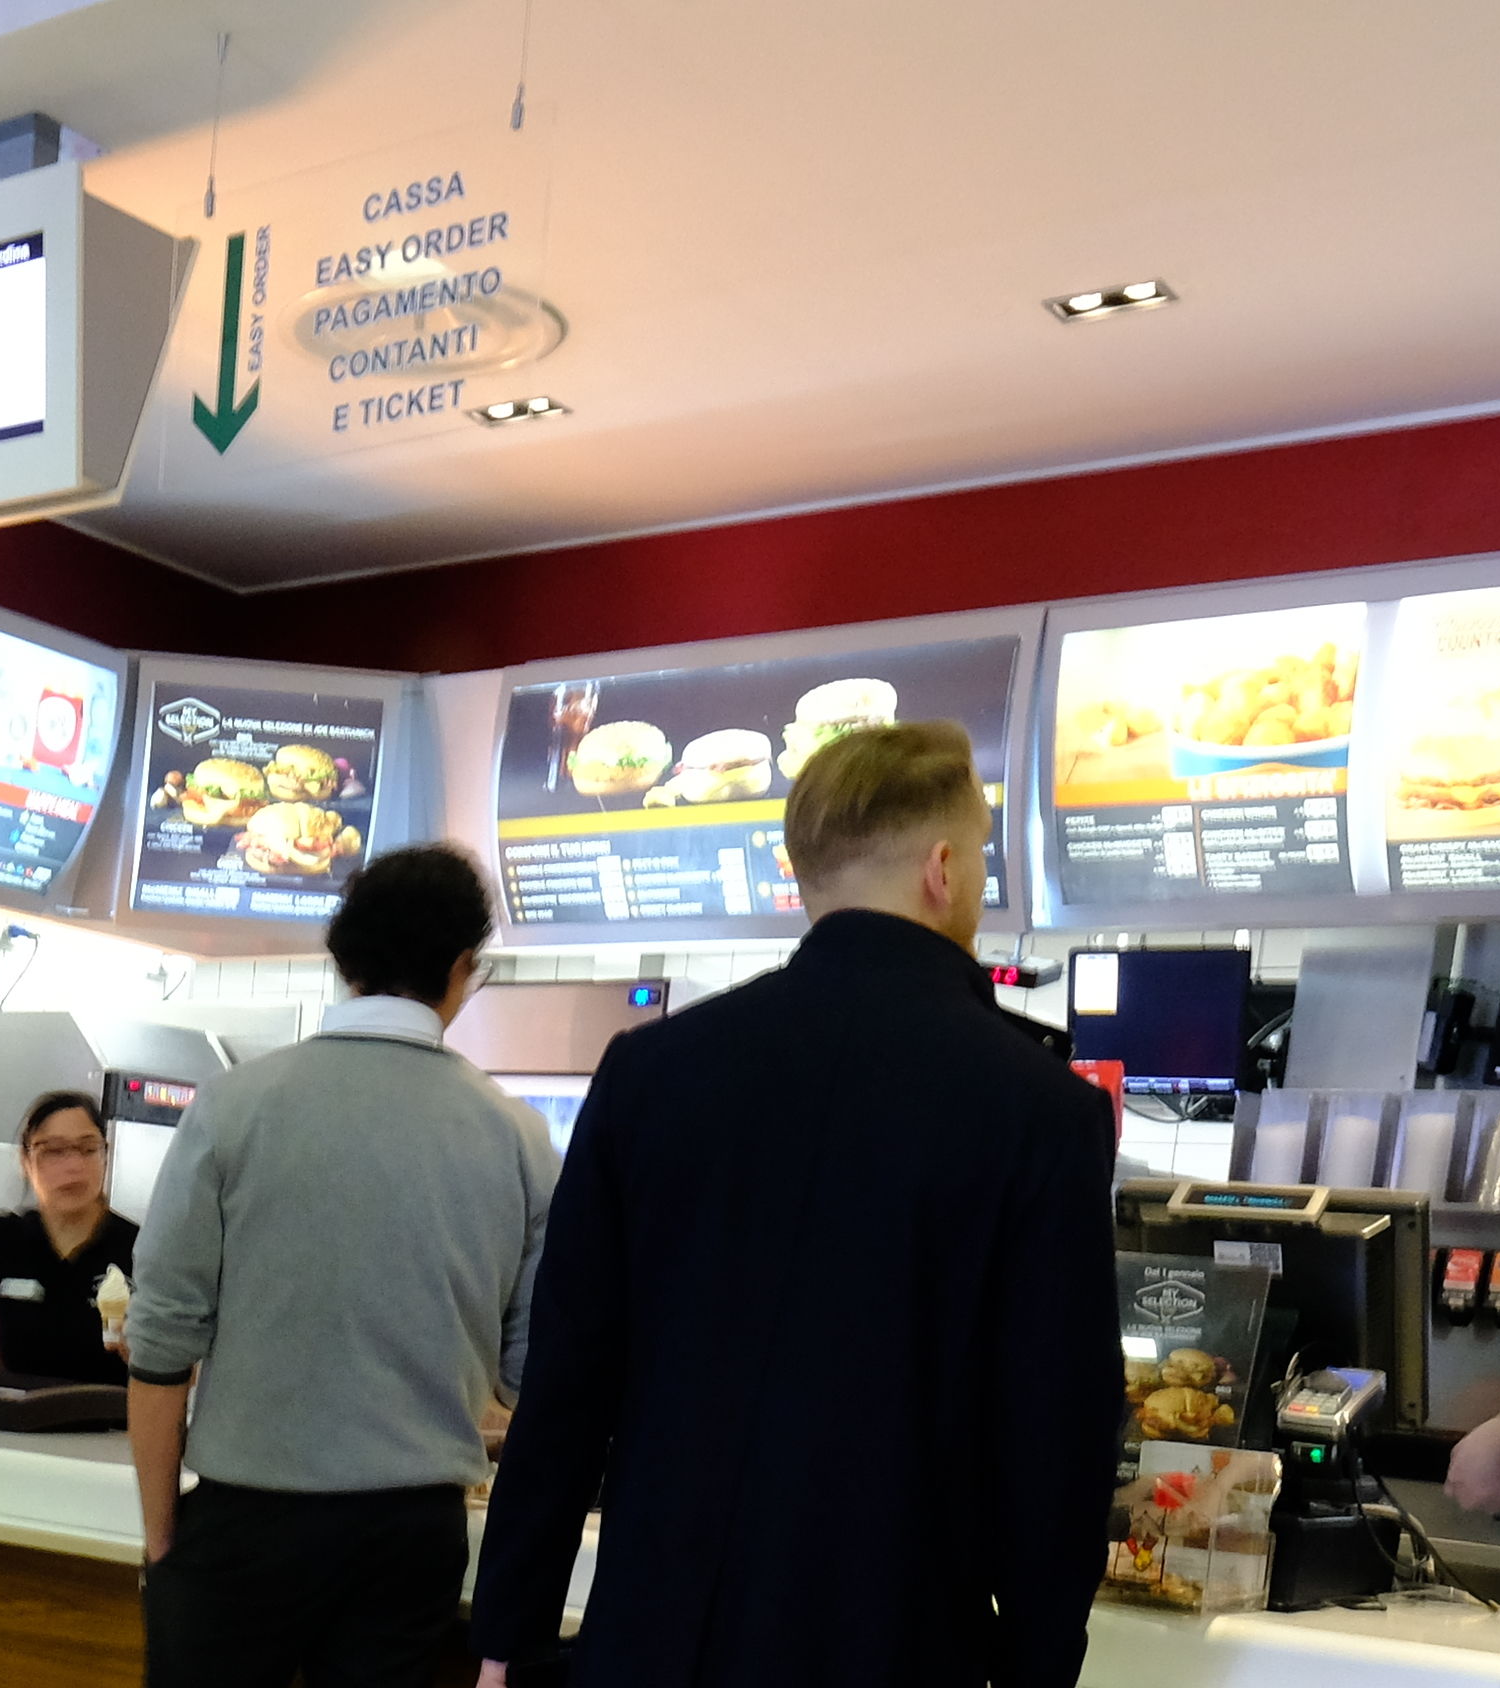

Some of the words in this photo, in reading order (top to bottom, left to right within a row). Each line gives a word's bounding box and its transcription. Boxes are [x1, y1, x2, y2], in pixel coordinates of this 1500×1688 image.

[363, 171, 465, 222] CASSA
[253, 225, 270, 305] ORDER
[316, 241, 393, 286] EASY
[401, 212, 509, 263] ORDER
[313, 266, 501, 335] PAGAMENTO
[248, 314, 263, 372] EASY
[329, 324, 478, 382] CONTANTI
[333, 404, 350, 431] E
[359, 379, 465, 425] TICKET
